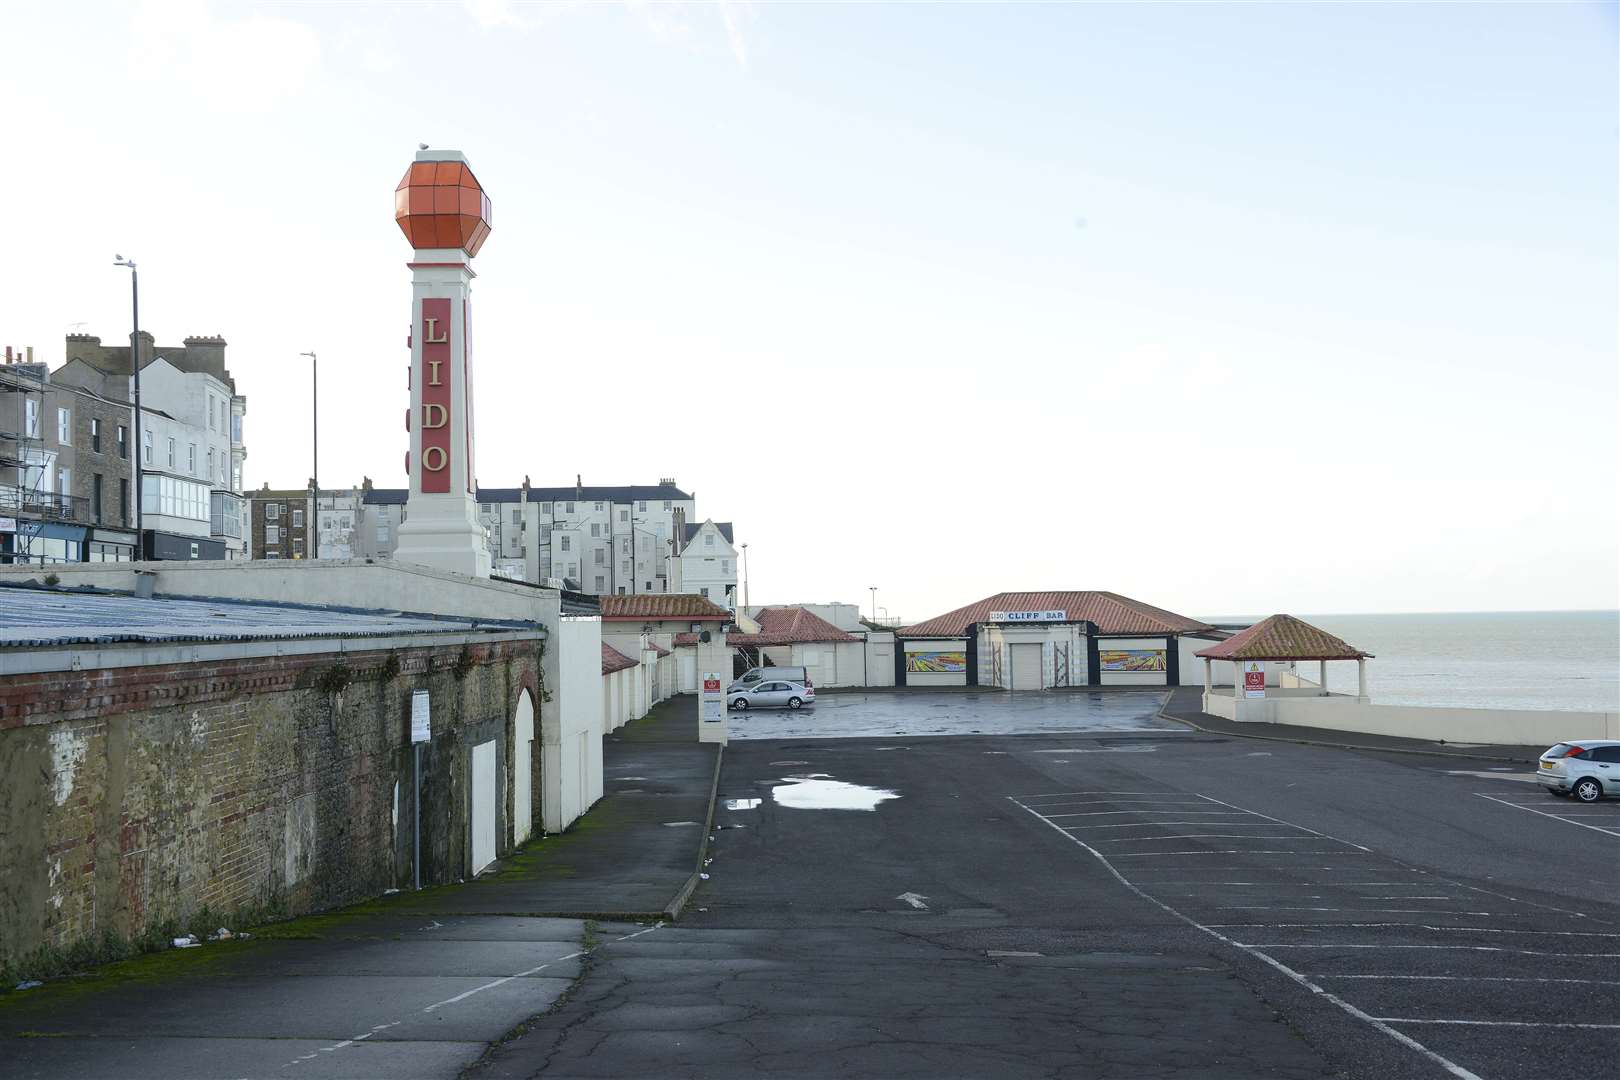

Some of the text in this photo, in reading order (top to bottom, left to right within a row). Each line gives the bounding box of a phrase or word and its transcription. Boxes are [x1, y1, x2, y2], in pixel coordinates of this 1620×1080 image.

[422, 318, 448, 472] LIDO
[1008, 612, 1040, 620] CLIFF
[1046, 611, 1064, 619] BAR
